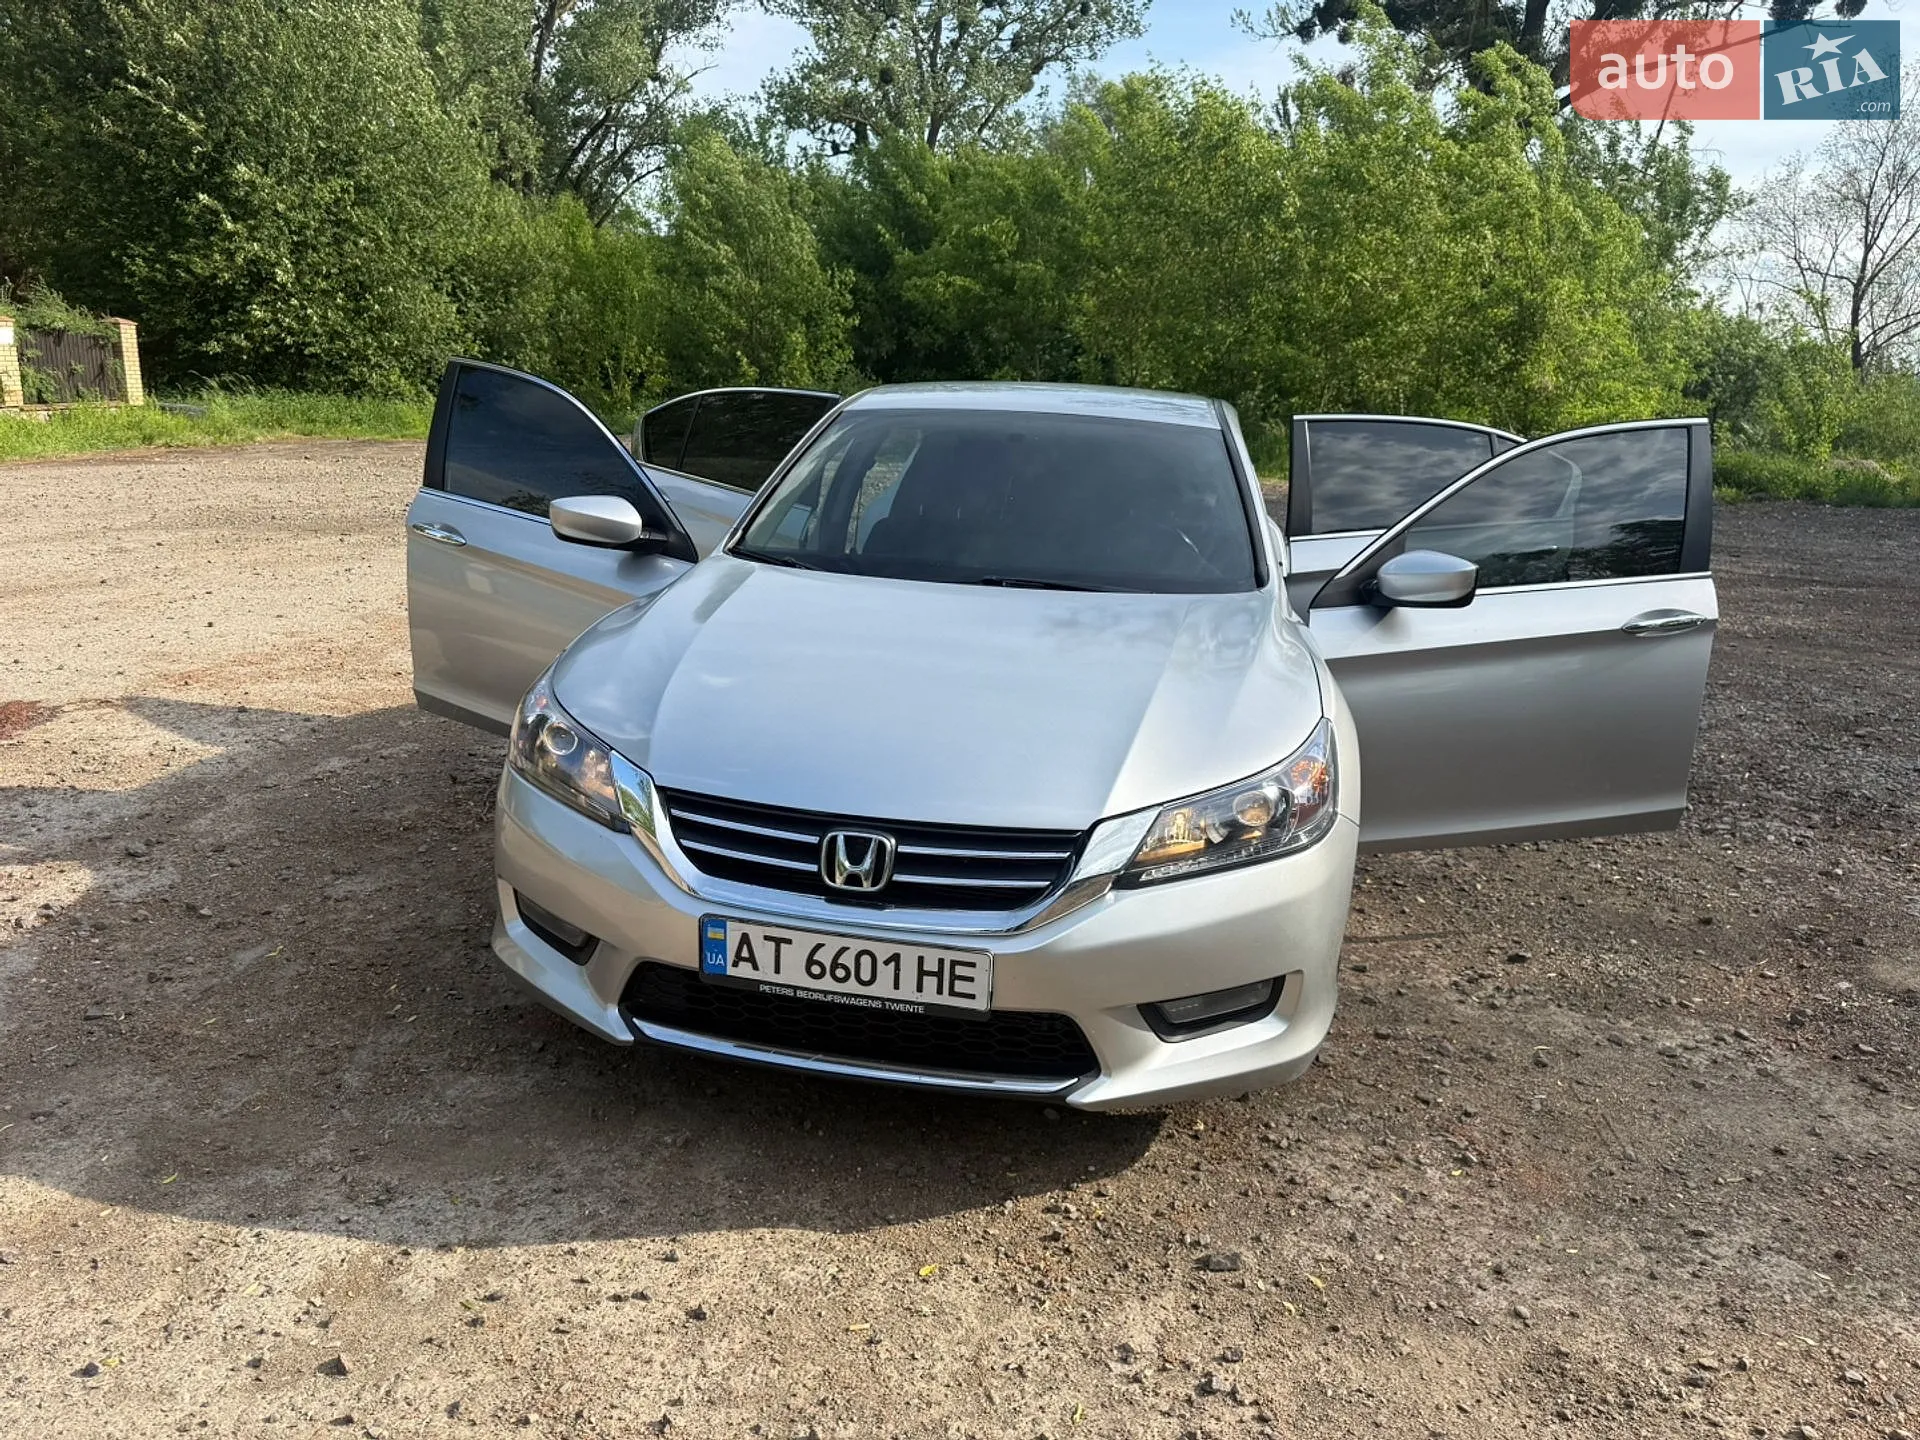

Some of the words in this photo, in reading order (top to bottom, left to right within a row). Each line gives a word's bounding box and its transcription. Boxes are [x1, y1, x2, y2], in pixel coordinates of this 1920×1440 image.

[707, 951, 725, 966] UA
[731, 932, 793, 975] AT
[805, 943, 902, 991] 6601
[916, 955, 977, 1000] HE
[759, 984, 794, 997] PETERS
[796, 990, 883, 1009] BEDRIJFSWAGENS
[884, 1002, 925, 1014] TWENTE
